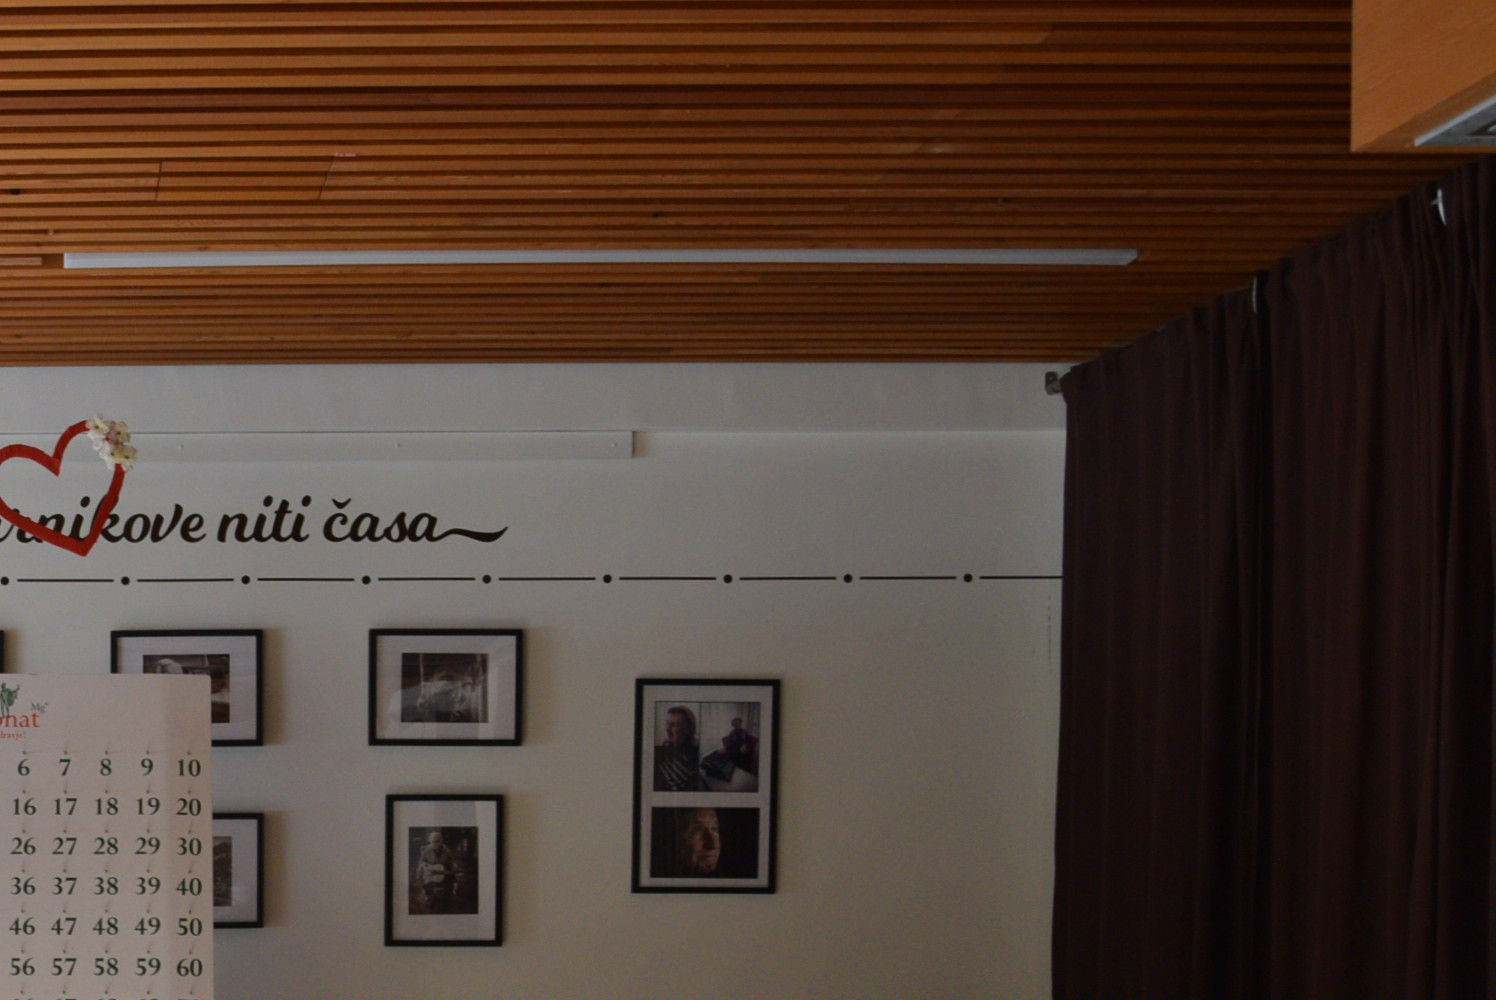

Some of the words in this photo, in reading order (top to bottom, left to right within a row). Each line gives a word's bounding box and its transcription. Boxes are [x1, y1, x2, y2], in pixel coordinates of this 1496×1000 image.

[217, 495, 310, 544] niti
[322, 497, 508, 544] časa
[17, 758, 31, 777] 6
[58, 758, 72, 777] 7
[99, 758, 113, 777] 8
[140, 758, 154, 776] 9
[177, 759, 202, 778] 10
[13, 797, 37, 816] 16
[54, 797, 78, 816] 17
[95, 797, 119, 816] 18
[136, 797, 161, 816] 19
[175, 797, 202, 817] 20
[10, 836, 37, 856] 26
[51, 836, 78, 856] 27
[93, 836, 119, 856] 28
[134, 836, 161, 855] 29
[177, 837, 203, 856] 30
[11, 876, 36, 896] 36
[53, 876, 78, 896] 37
[94, 876, 119, 896] 38
[136, 876, 161, 896] 39
[175, 877, 203, 897] 40
[8, 917, 36, 936] 46
[50, 916, 78, 936] 47
[92, 916, 119, 936] 48
[133, 916, 162, 936] 49
[177, 917, 203, 937] 50
[9, 957, 36, 976] 56
[52, 957, 78, 977] 57
[94, 957, 119, 977] 58
[136, 957, 162, 977] 59
[176, 958, 203, 978] 60
